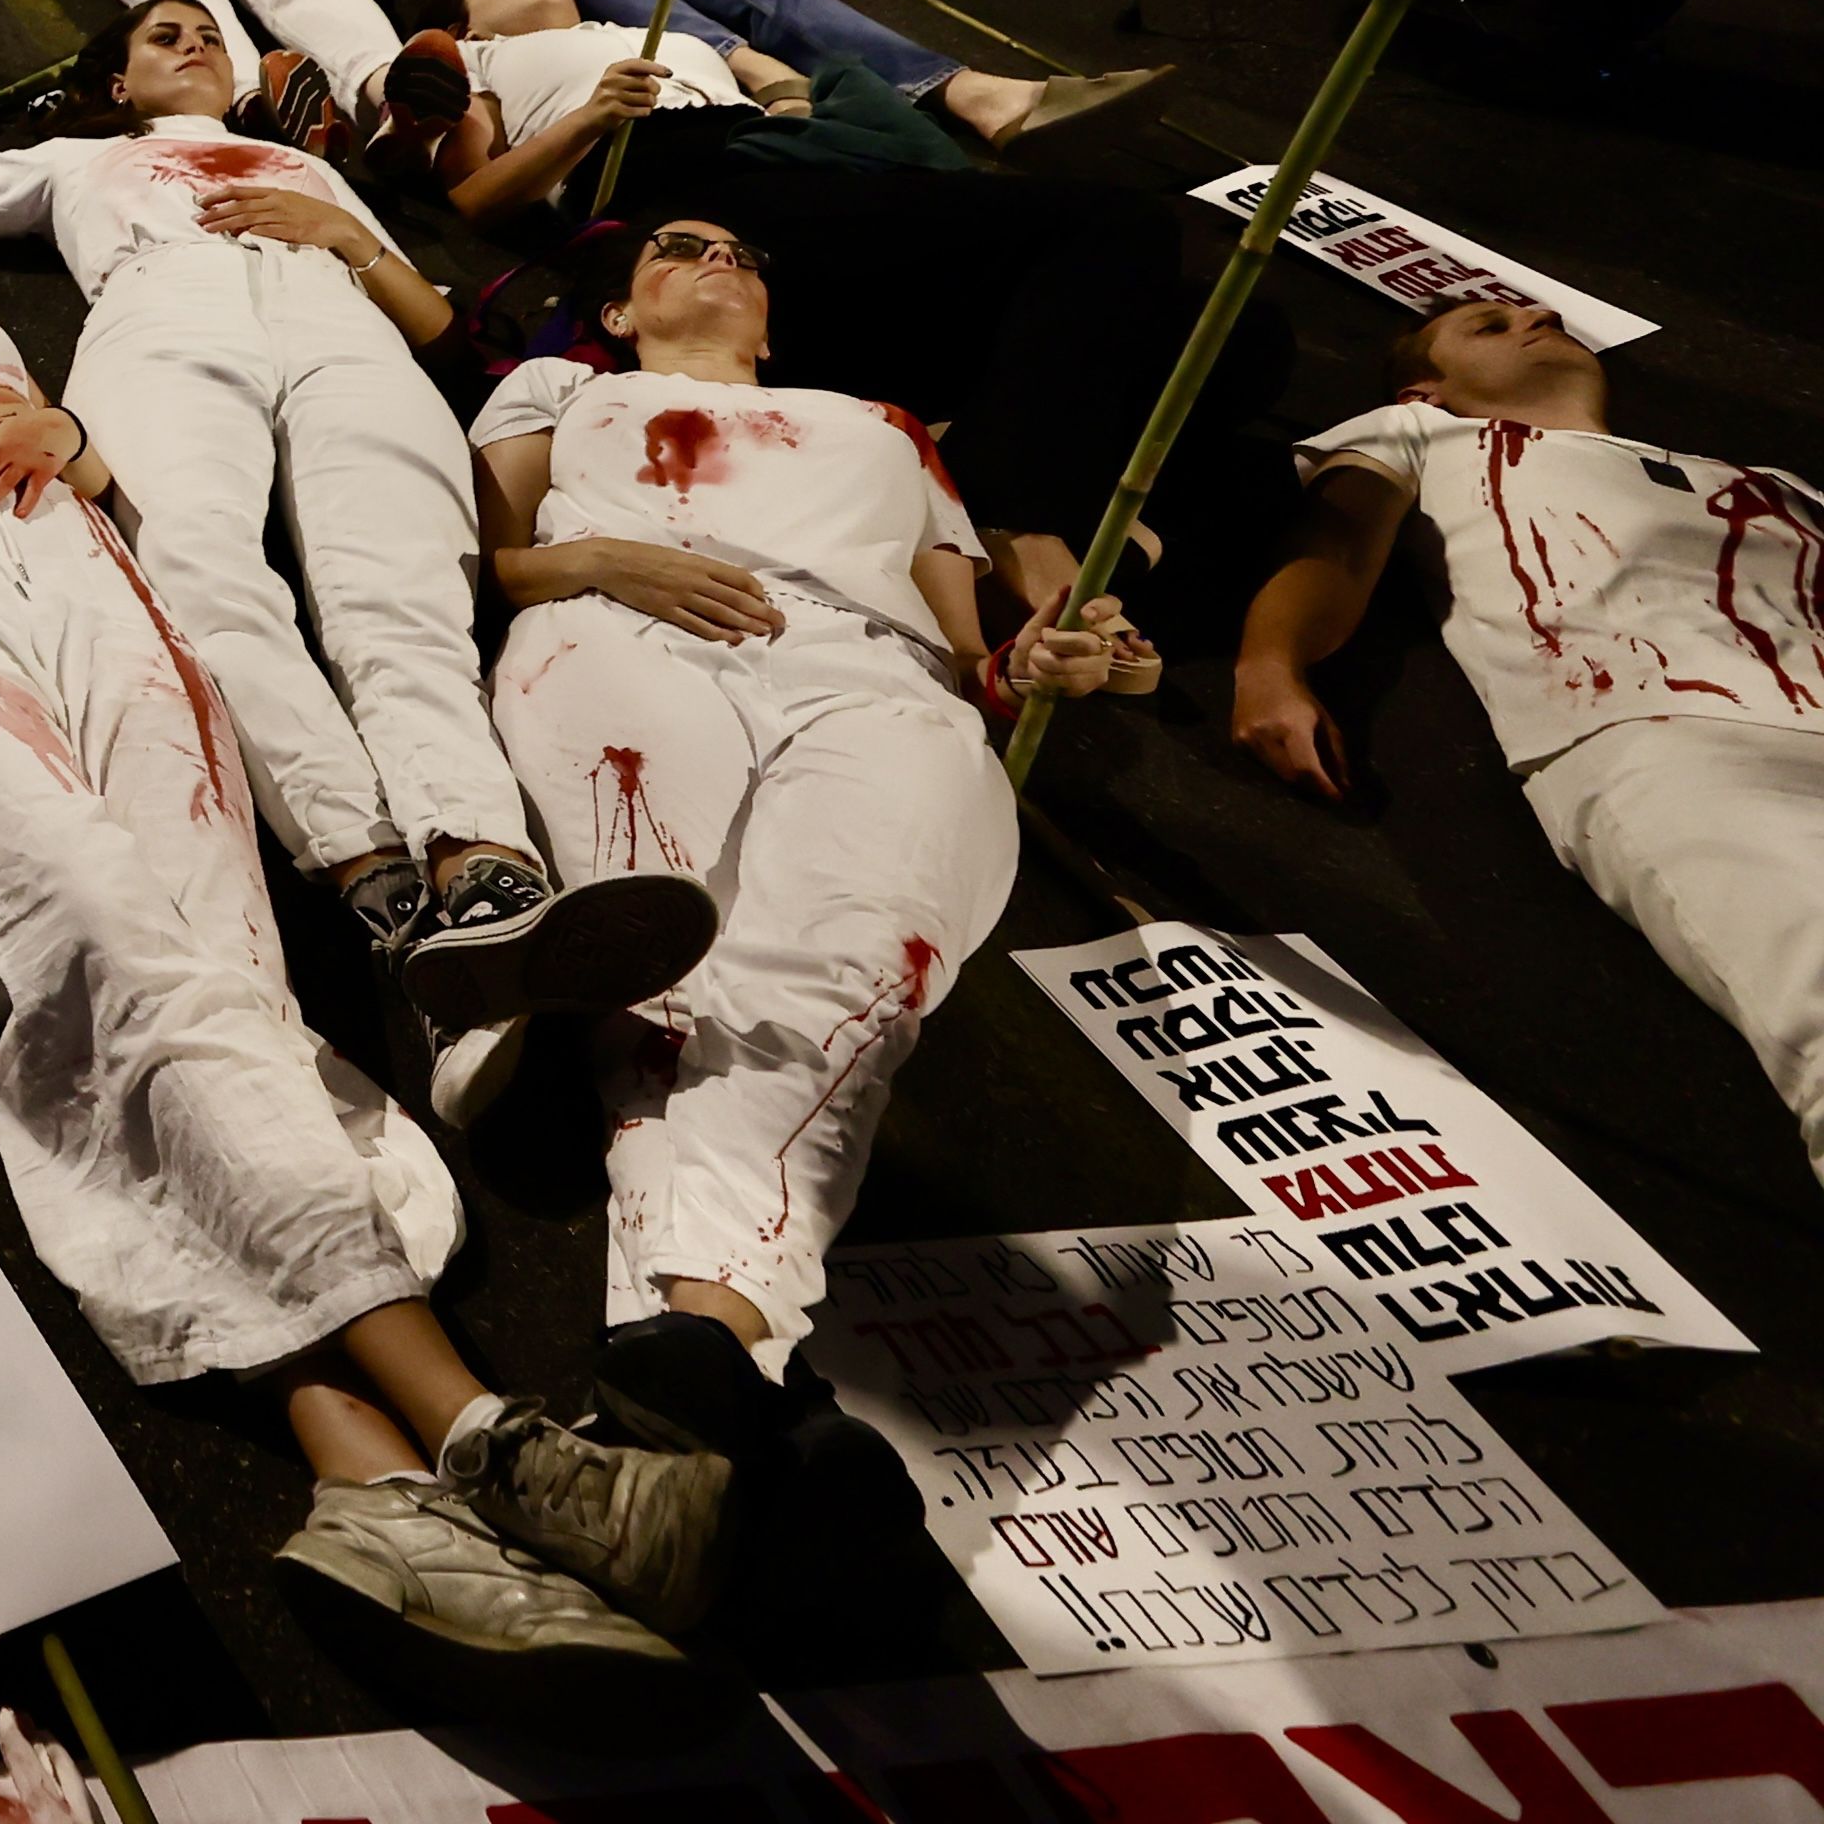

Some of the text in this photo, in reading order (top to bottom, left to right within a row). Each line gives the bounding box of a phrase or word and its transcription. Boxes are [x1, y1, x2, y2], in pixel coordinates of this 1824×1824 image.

[1378, 253, 1495, 300] שנציל
[1115, 987, 1325, 1064] עסקה
[1156, 1037, 1334, 1112] אותן.
[1216, 1090, 1442, 1165] שנציל
[1260, 1143, 1480, 1223] מתות
[978, 1238, 1059, 1296] לא
[1057, 1234, 1215, 1291] שאומר
[1229, 1227, 1314, 1278] מי
[1318, 1201, 1511, 1283] שלנו
[854, 1284, 1369, 1374] חטופים בכל מחיר
[1376, 1258, 1666, 1344] האחיות
[900, 1341, 1415, 1436] שישלח את הילדים שלו
[1112, 1427, 1305, 1486] חטופים
[1315, 1402, 1484, 1477] להיות
[988, 1474, 1543, 1569] הילדים החטופים שווים
[1264, 1552, 1457, 1637] לילדים
[1449, 1551, 1626, 1633] בדיוק
